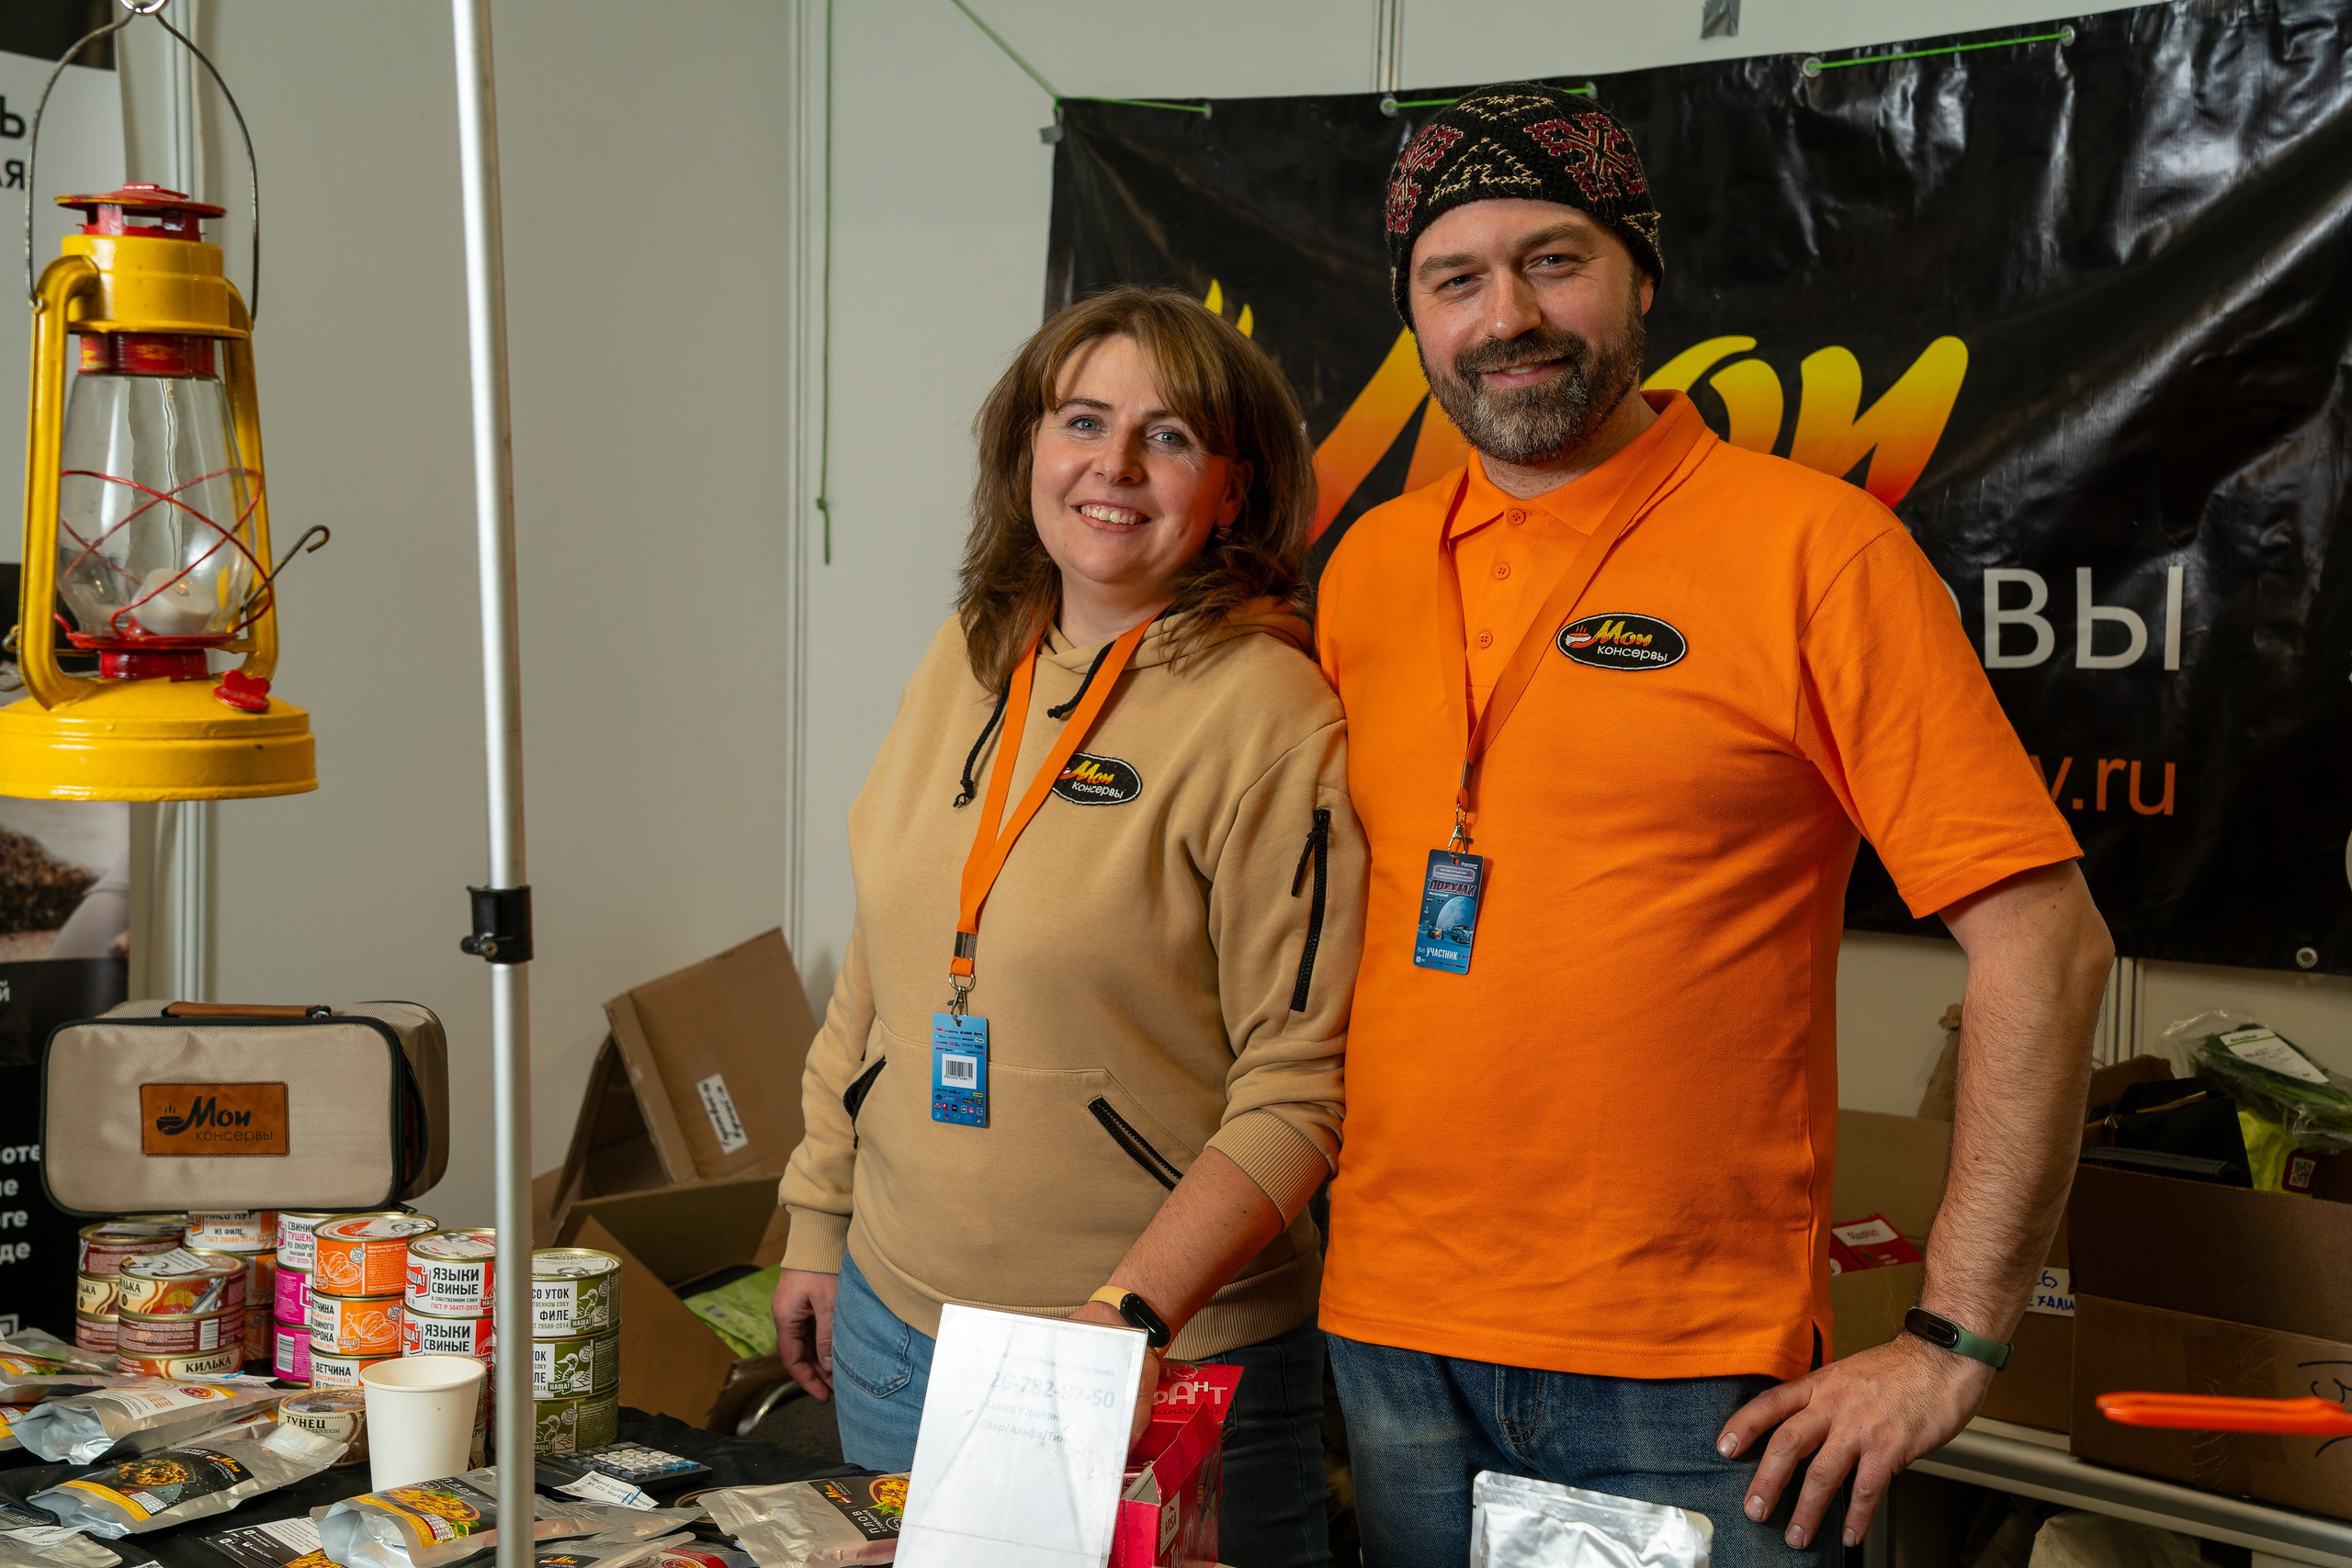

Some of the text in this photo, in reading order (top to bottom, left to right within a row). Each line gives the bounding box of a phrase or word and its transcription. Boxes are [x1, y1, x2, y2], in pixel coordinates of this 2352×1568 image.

[1593, 619, 1653, 647] Мои
[1597, 645, 1668, 662] консервы
[1071, 760, 1115, 784] Мои
[1071, 781, 1125, 799] консервы
[1426, 946, 1459, 962] УЧАСТНИК
[186, 1096, 252, 1129] Мои
[195, 1131, 273, 1144] консервы
[0, 1145, 40, 1166] оте
[432, 1267, 480, 1281] ЯЗЫКИ
[431, 1281, 479, 1295] СВИНЫЕ
[545, 1288, 570, 1300] УТОК
[430, 1302, 443, 1310] ГОСТ
[539, 1309, 570, 1322] ФИЛЕ
[424, 1324, 470, 1338] ЯЗЫКИ
[424, 1338, 470, 1352] СВИНЫЕ
[186, 1356, 232, 1373] КИЛЬКА
[315, 1361, 352, 1377] ВЕТЧИНА
[1073, 1362, 1115, 1379] телефона
[549, 1382, 571, 1392] НАША!
[983, 1399, 1016, 1414] Ольга
[286, 1415, 326, 1429] ТУНЕЦ
[852, 1509, 881, 1534] ПЛОВ
